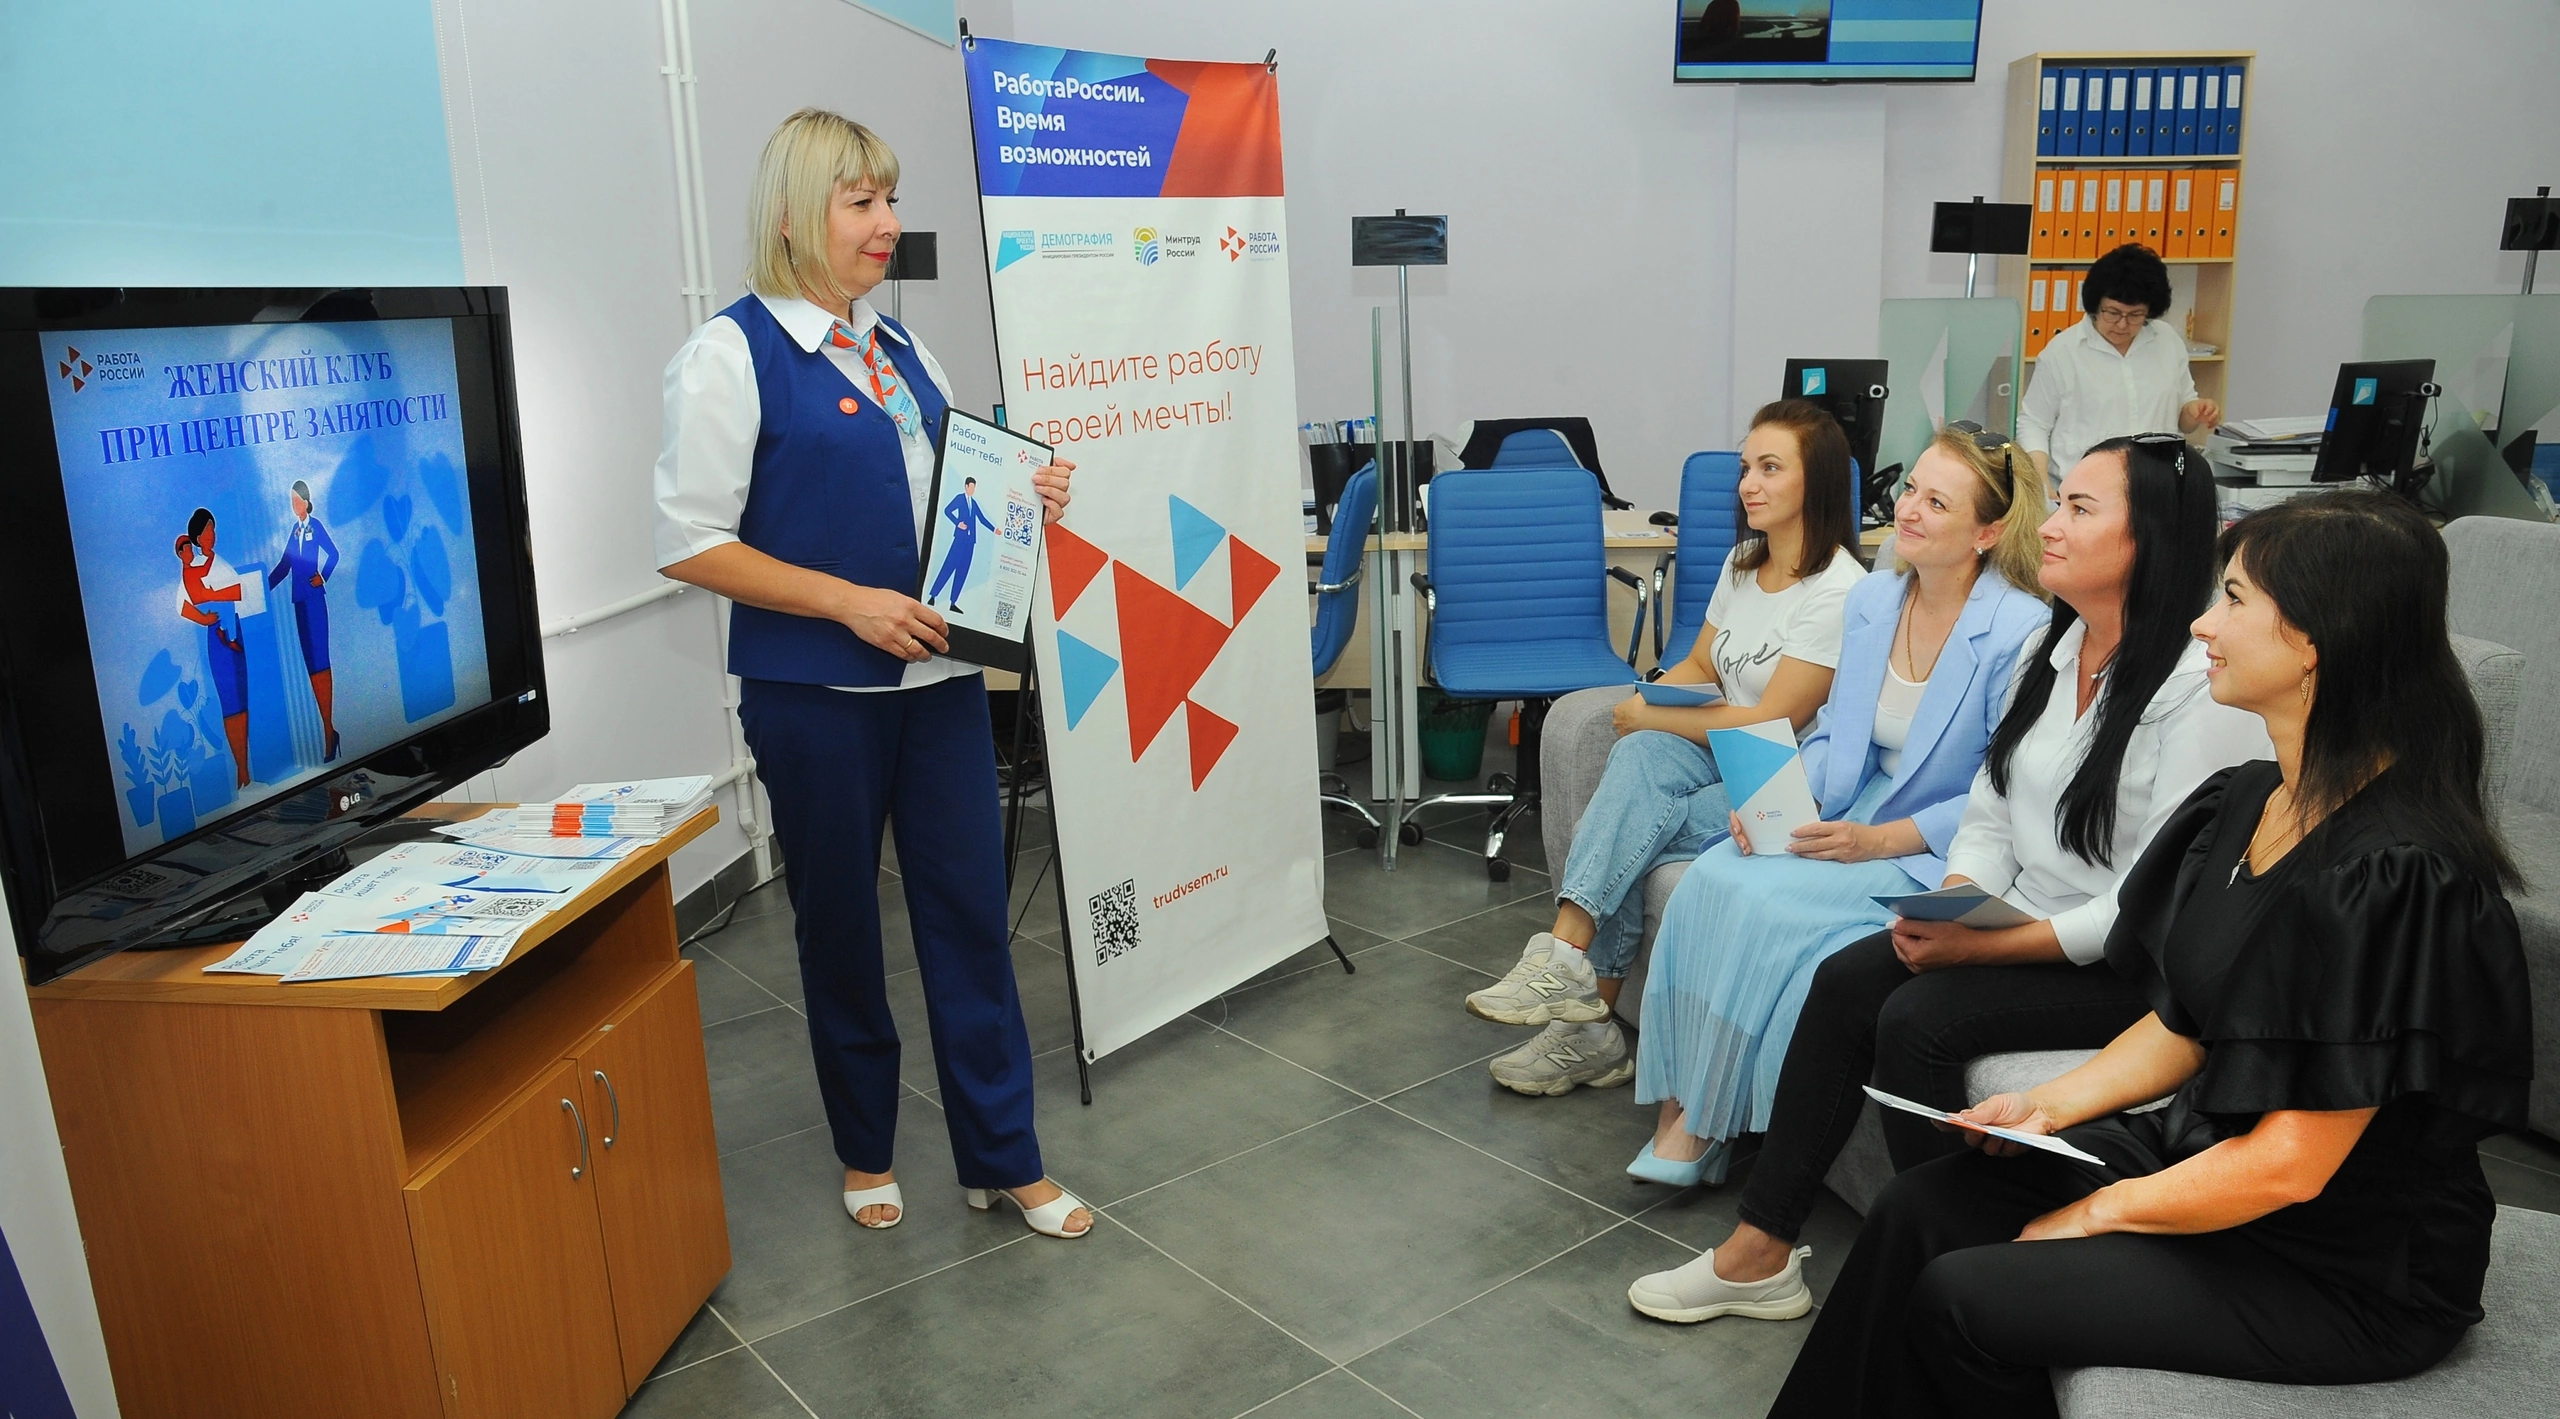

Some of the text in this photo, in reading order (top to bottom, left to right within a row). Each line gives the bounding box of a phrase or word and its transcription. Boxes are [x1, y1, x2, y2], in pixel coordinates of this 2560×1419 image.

[993, 71, 1145, 103] РаботаРоссии.
[997, 106, 1065, 134] Время
[1000, 145, 1151, 168] возможностей
[1041, 233, 1113, 248] ДЕМОГРАФИЯ
[1165, 235, 1201, 245] Минтруд
[1249, 232, 1278, 242] РАБОТА
[1166, 249, 1195, 258] России
[1249, 244, 1280, 254] РОССИИ
[97, 353, 141, 366] РАБОТА
[1023, 340, 1262, 391] Найдите работу
[100, 368, 145, 381] РОССИИ
[164, 349, 393, 399] ЖЕНСКИЙ КЛУБ
[1029, 391, 1232, 445] своей мечты!
[98, 393, 449, 465] ПРИ ЦЕНТРЕ ЗАНЯТОСТИ
[952, 424, 986, 445] Работа
[950, 440, 1003, 466] ищет тебя!
[350, 792, 361, 805] LG
[334, 873, 370, 894] Работа
[354, 880, 380, 897] ищет
[1153, 865, 1228, 909] trudvsem.ru
[221, 949, 266, 970] Работа
[242, 935, 303, 970] ищет тебя!
